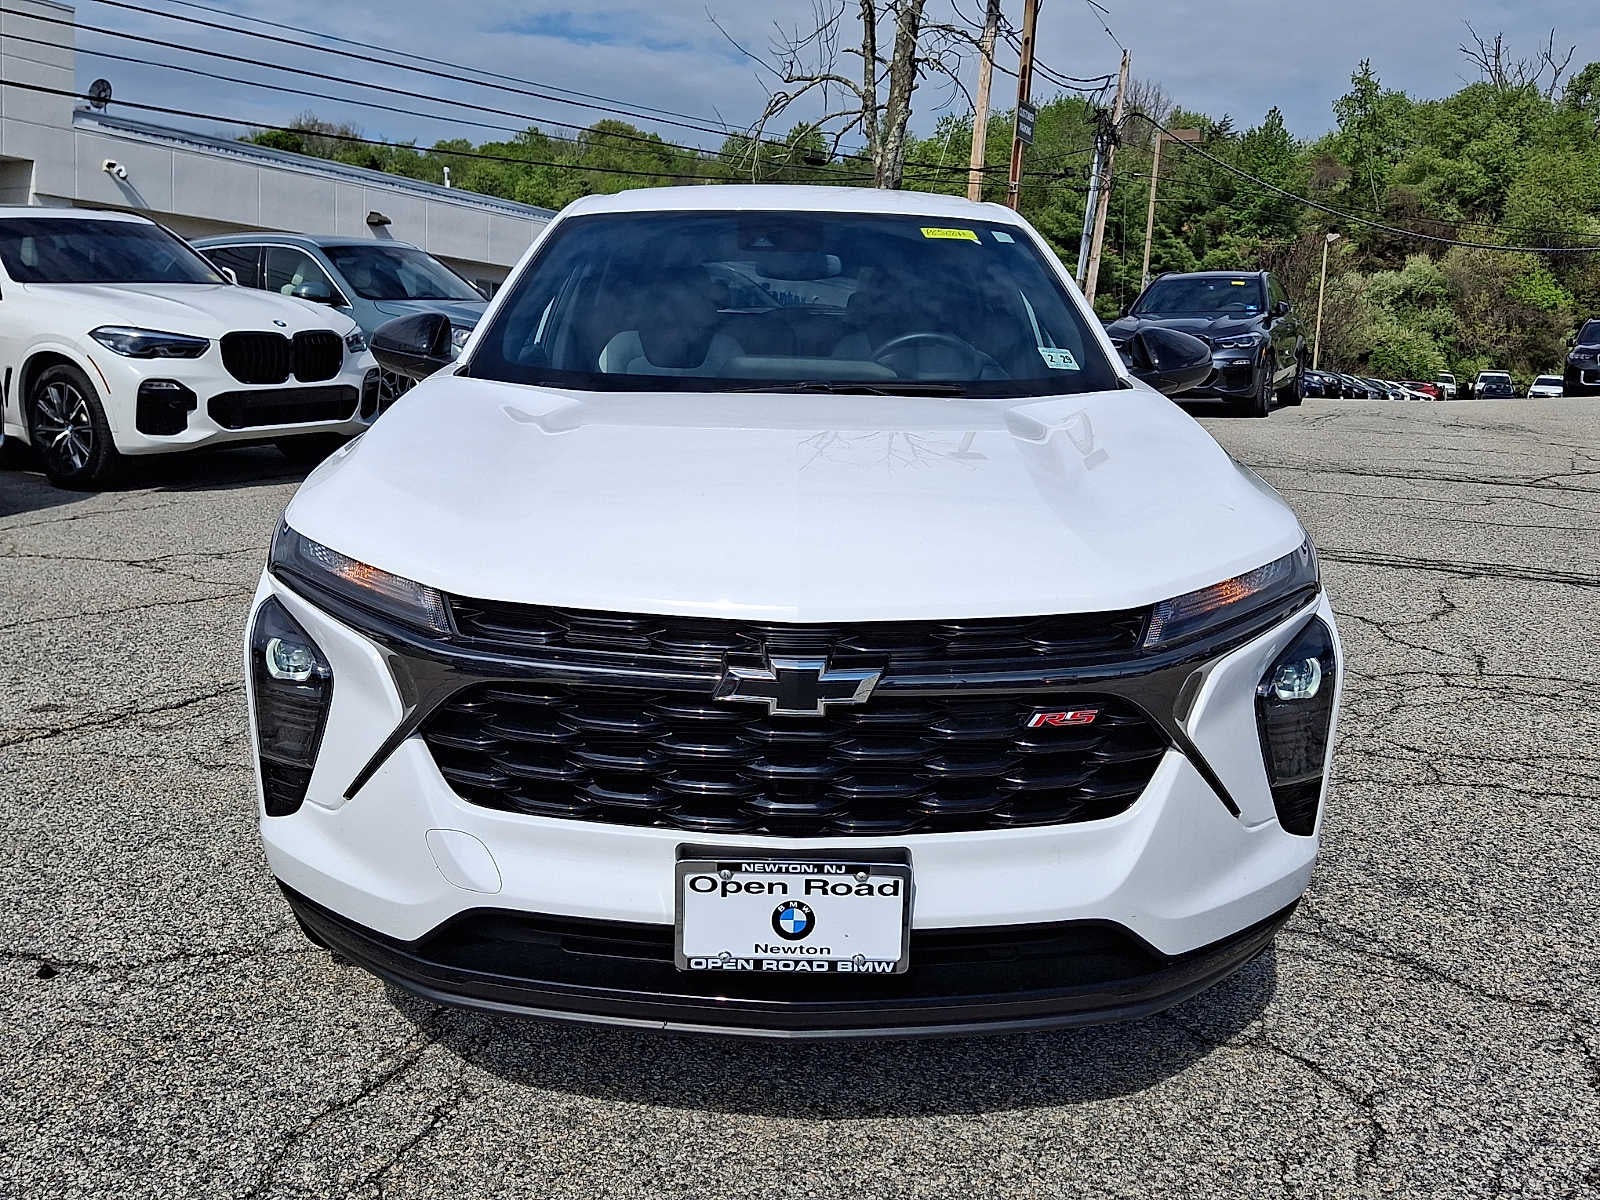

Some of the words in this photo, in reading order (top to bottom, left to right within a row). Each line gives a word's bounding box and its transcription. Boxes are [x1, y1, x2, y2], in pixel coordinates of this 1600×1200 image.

[1047, 354, 1056, 363] 2
[1059, 355, 1073, 364] 29
[1027, 710, 1099, 728] RS
[742, 863, 818, 874] NEWTON,
[824, 865, 846, 874] NJ
[689, 876, 788, 897] Open
[804, 878, 900, 897] Road
[777, 901, 811, 914] BMW
[754, 944, 831, 956] Newton
[690, 959, 753, 971] OPEN
[762, 960, 829, 972] ROAD
[837, 961, 895, 973] BMW
